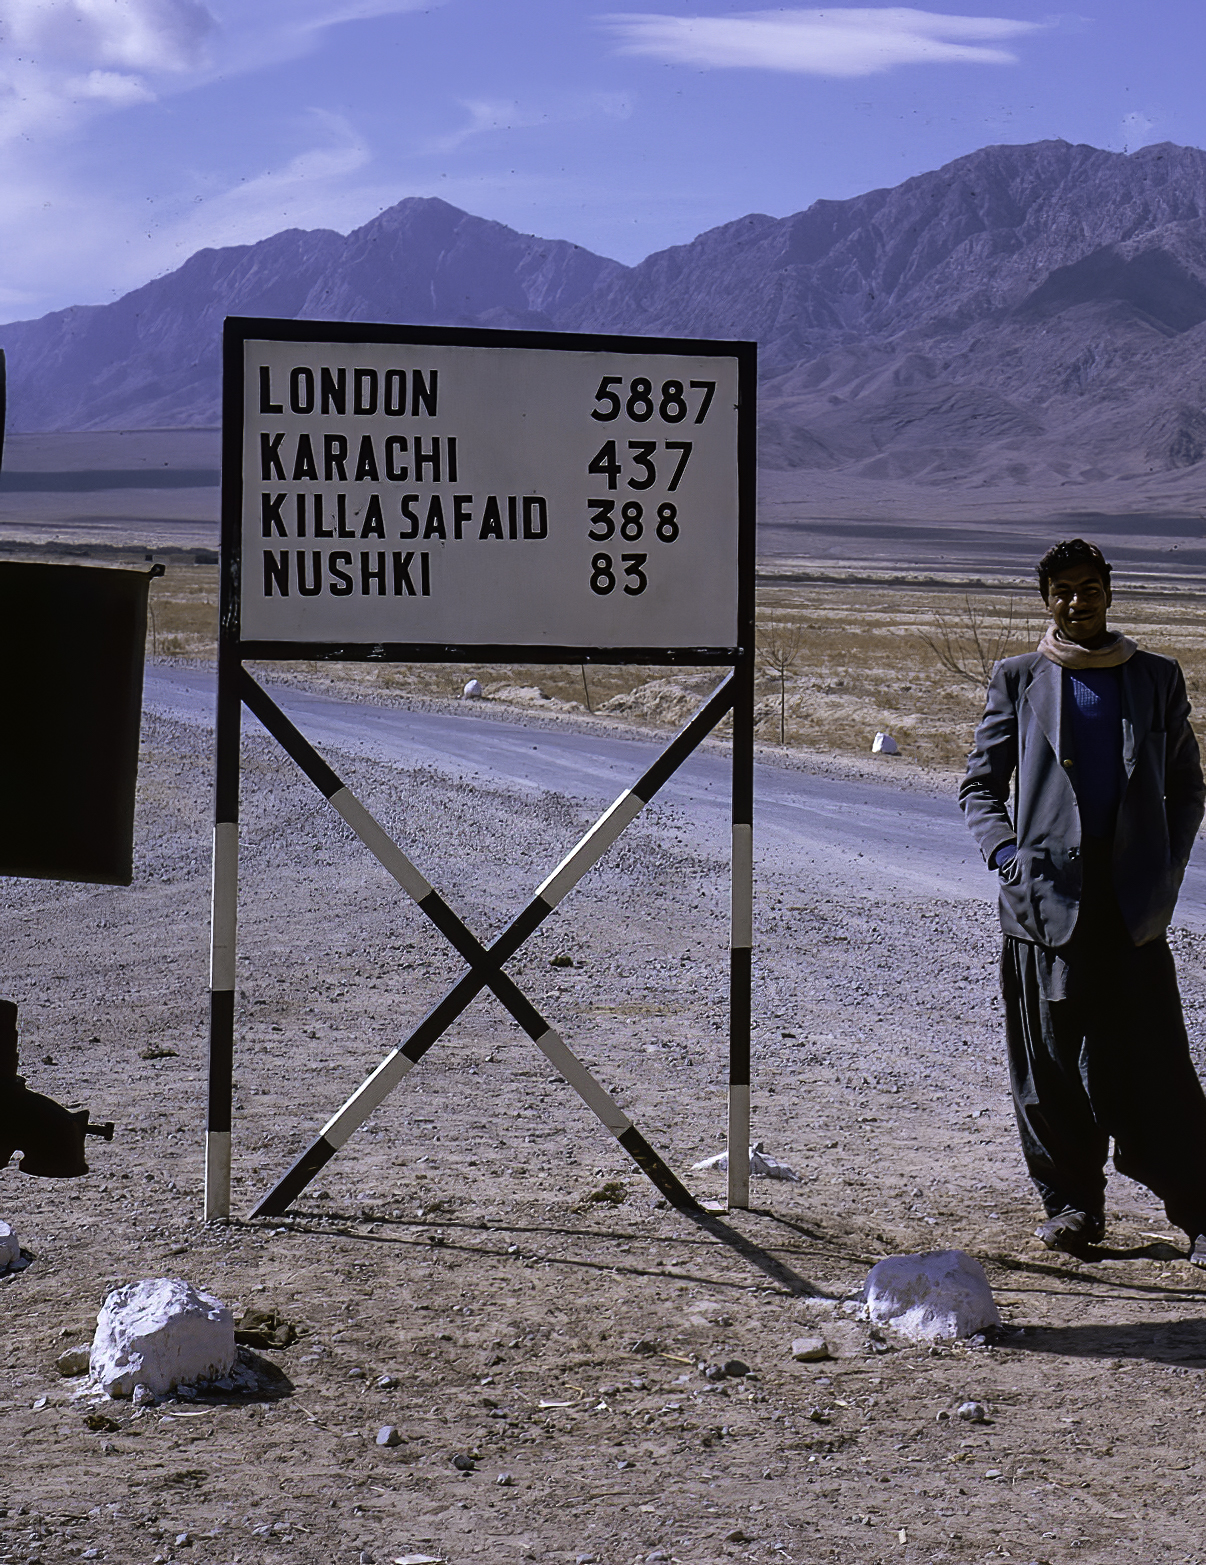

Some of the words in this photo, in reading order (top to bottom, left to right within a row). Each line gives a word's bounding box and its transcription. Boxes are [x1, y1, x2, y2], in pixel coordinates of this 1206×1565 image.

[259, 366, 438, 417] LONDON
[591, 376, 716, 424] 5887
[260, 433, 458, 483] KARACHI
[588, 440, 693, 491] 437
[261, 493, 385, 539] KILLA
[400, 495, 549, 541] SAFAID
[587, 499, 680, 542] 388
[262, 550, 431, 597] NUSHKI
[590, 553, 648, 596] 83
